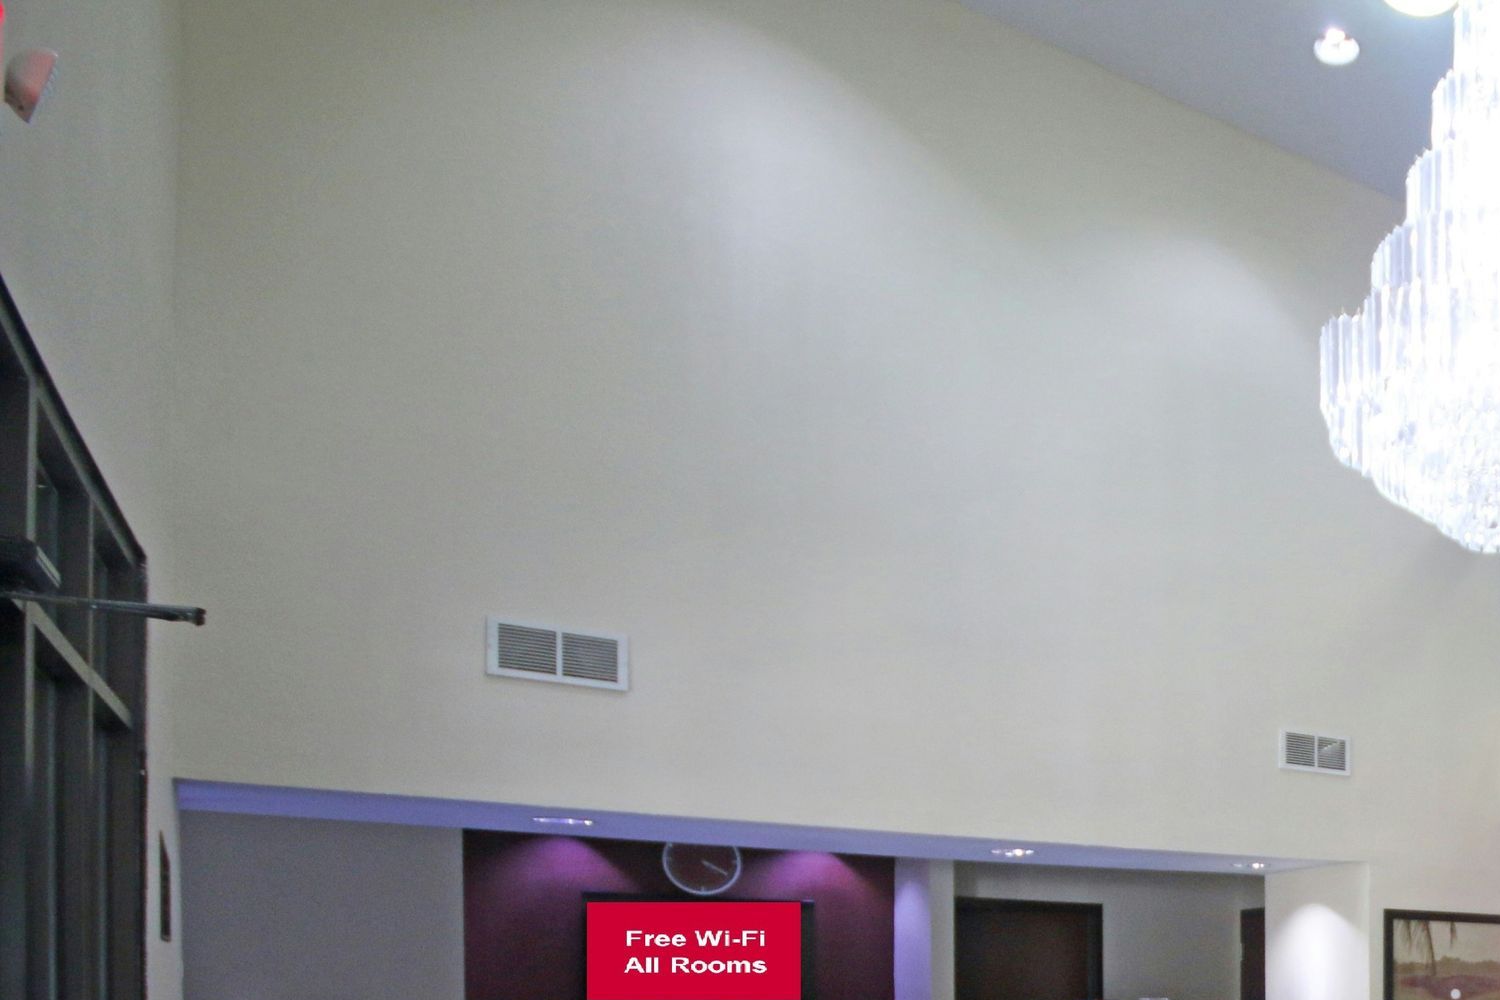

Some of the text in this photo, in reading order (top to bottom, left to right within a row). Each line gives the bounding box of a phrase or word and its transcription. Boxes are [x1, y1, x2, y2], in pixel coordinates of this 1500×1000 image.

[626, 930, 765, 947] Free Wi-Fi
[624, 956, 767, 974] All Rooms
